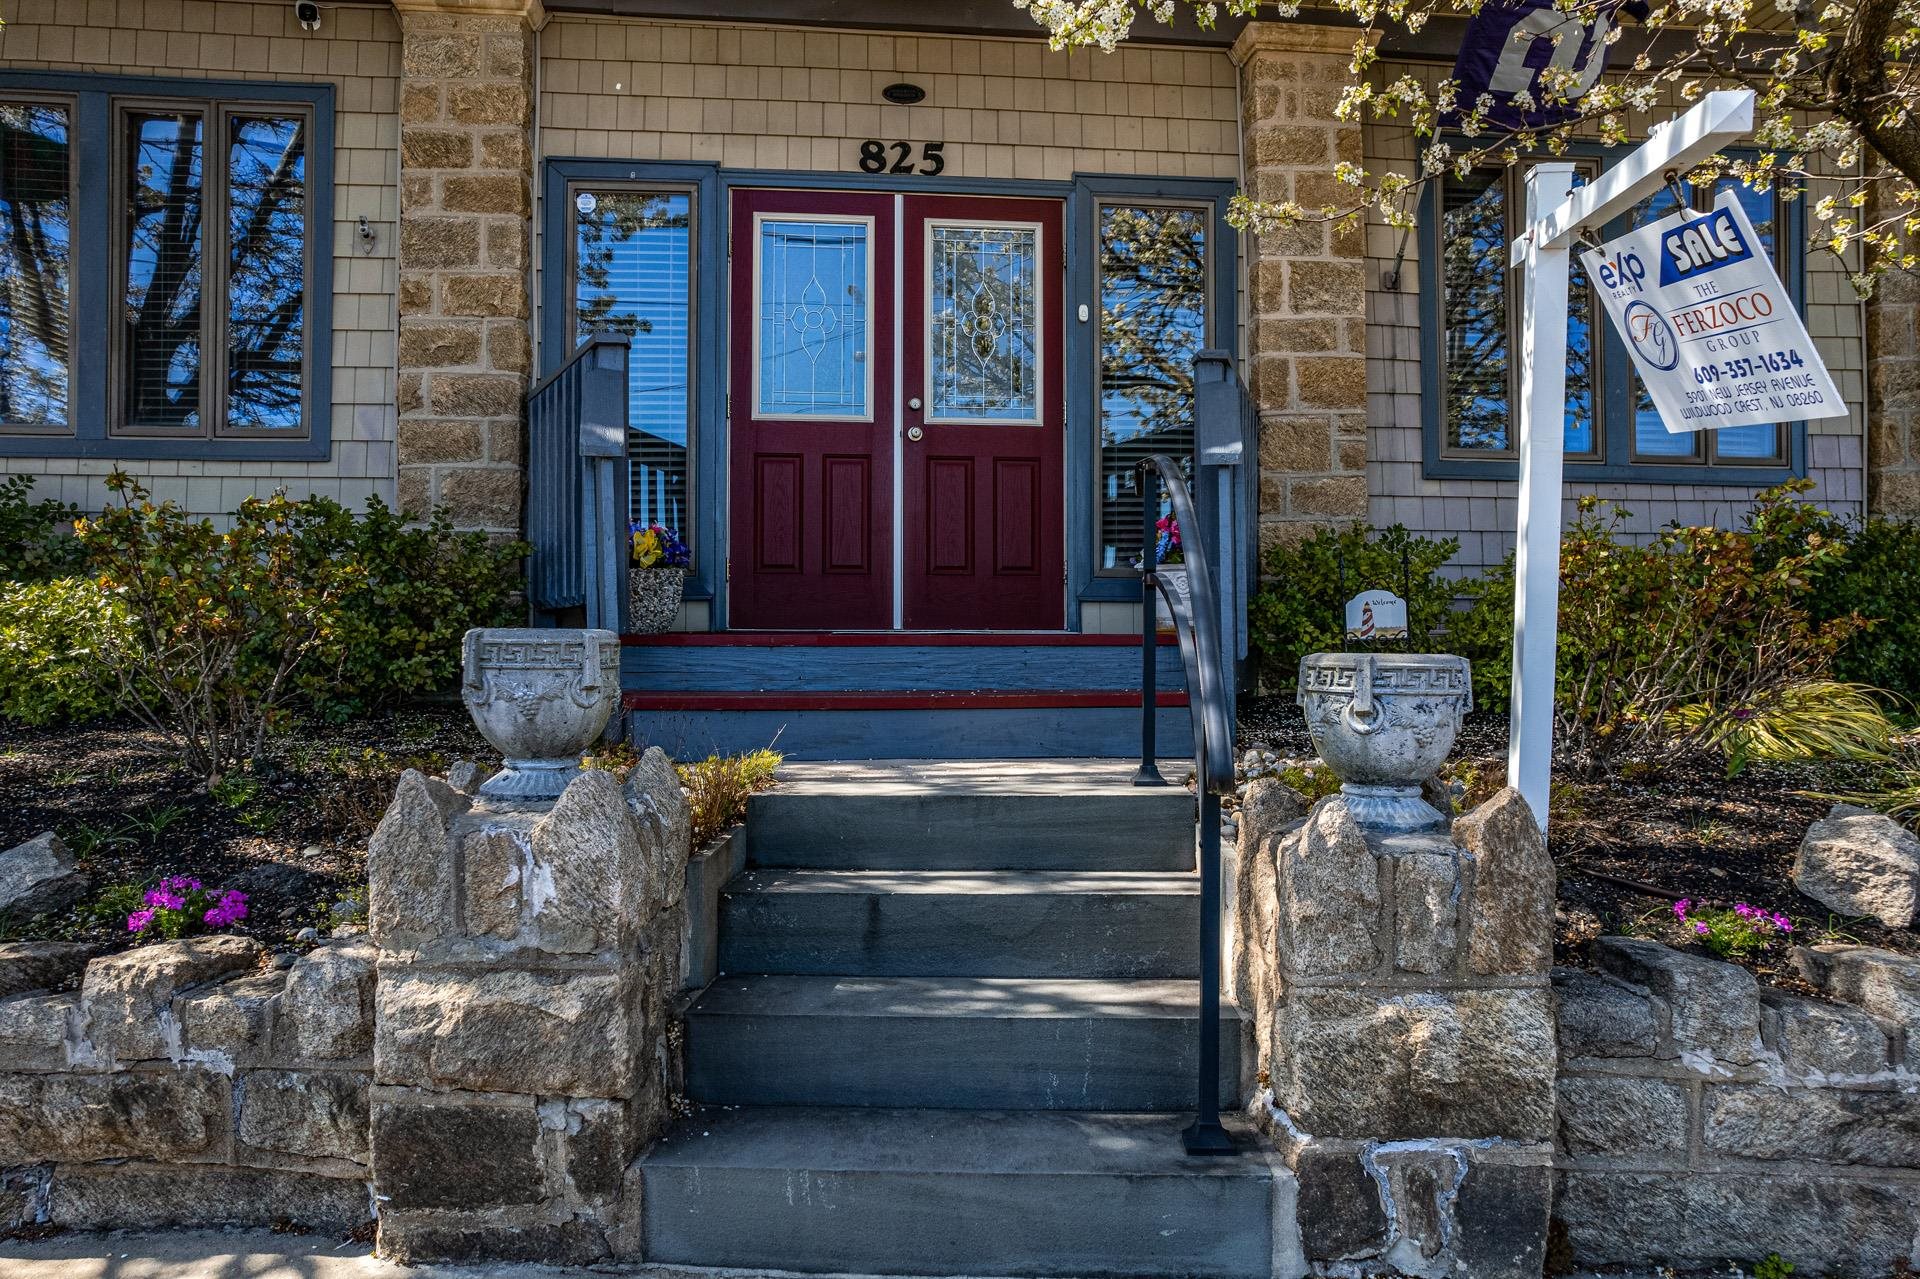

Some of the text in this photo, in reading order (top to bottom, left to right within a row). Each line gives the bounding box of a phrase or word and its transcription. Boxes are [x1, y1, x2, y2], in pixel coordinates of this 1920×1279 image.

[859, 140, 945, 176] 825
[1666, 214, 1744, 275] SALE
[1611, 285, 1637, 299] REALTY
[1692, 280, 1719, 298] THE
[1671, 292, 1774, 338] FERZOCO
[1706, 330, 1762, 353] GROUP
[1693, 348, 1804, 384] 609-357-1634
[1685, 373, 1816, 404] 5901 NEW JERSEY AVENUE
[1679, 390, 1824, 420] WILDWOOD CREST, NJ 08260
